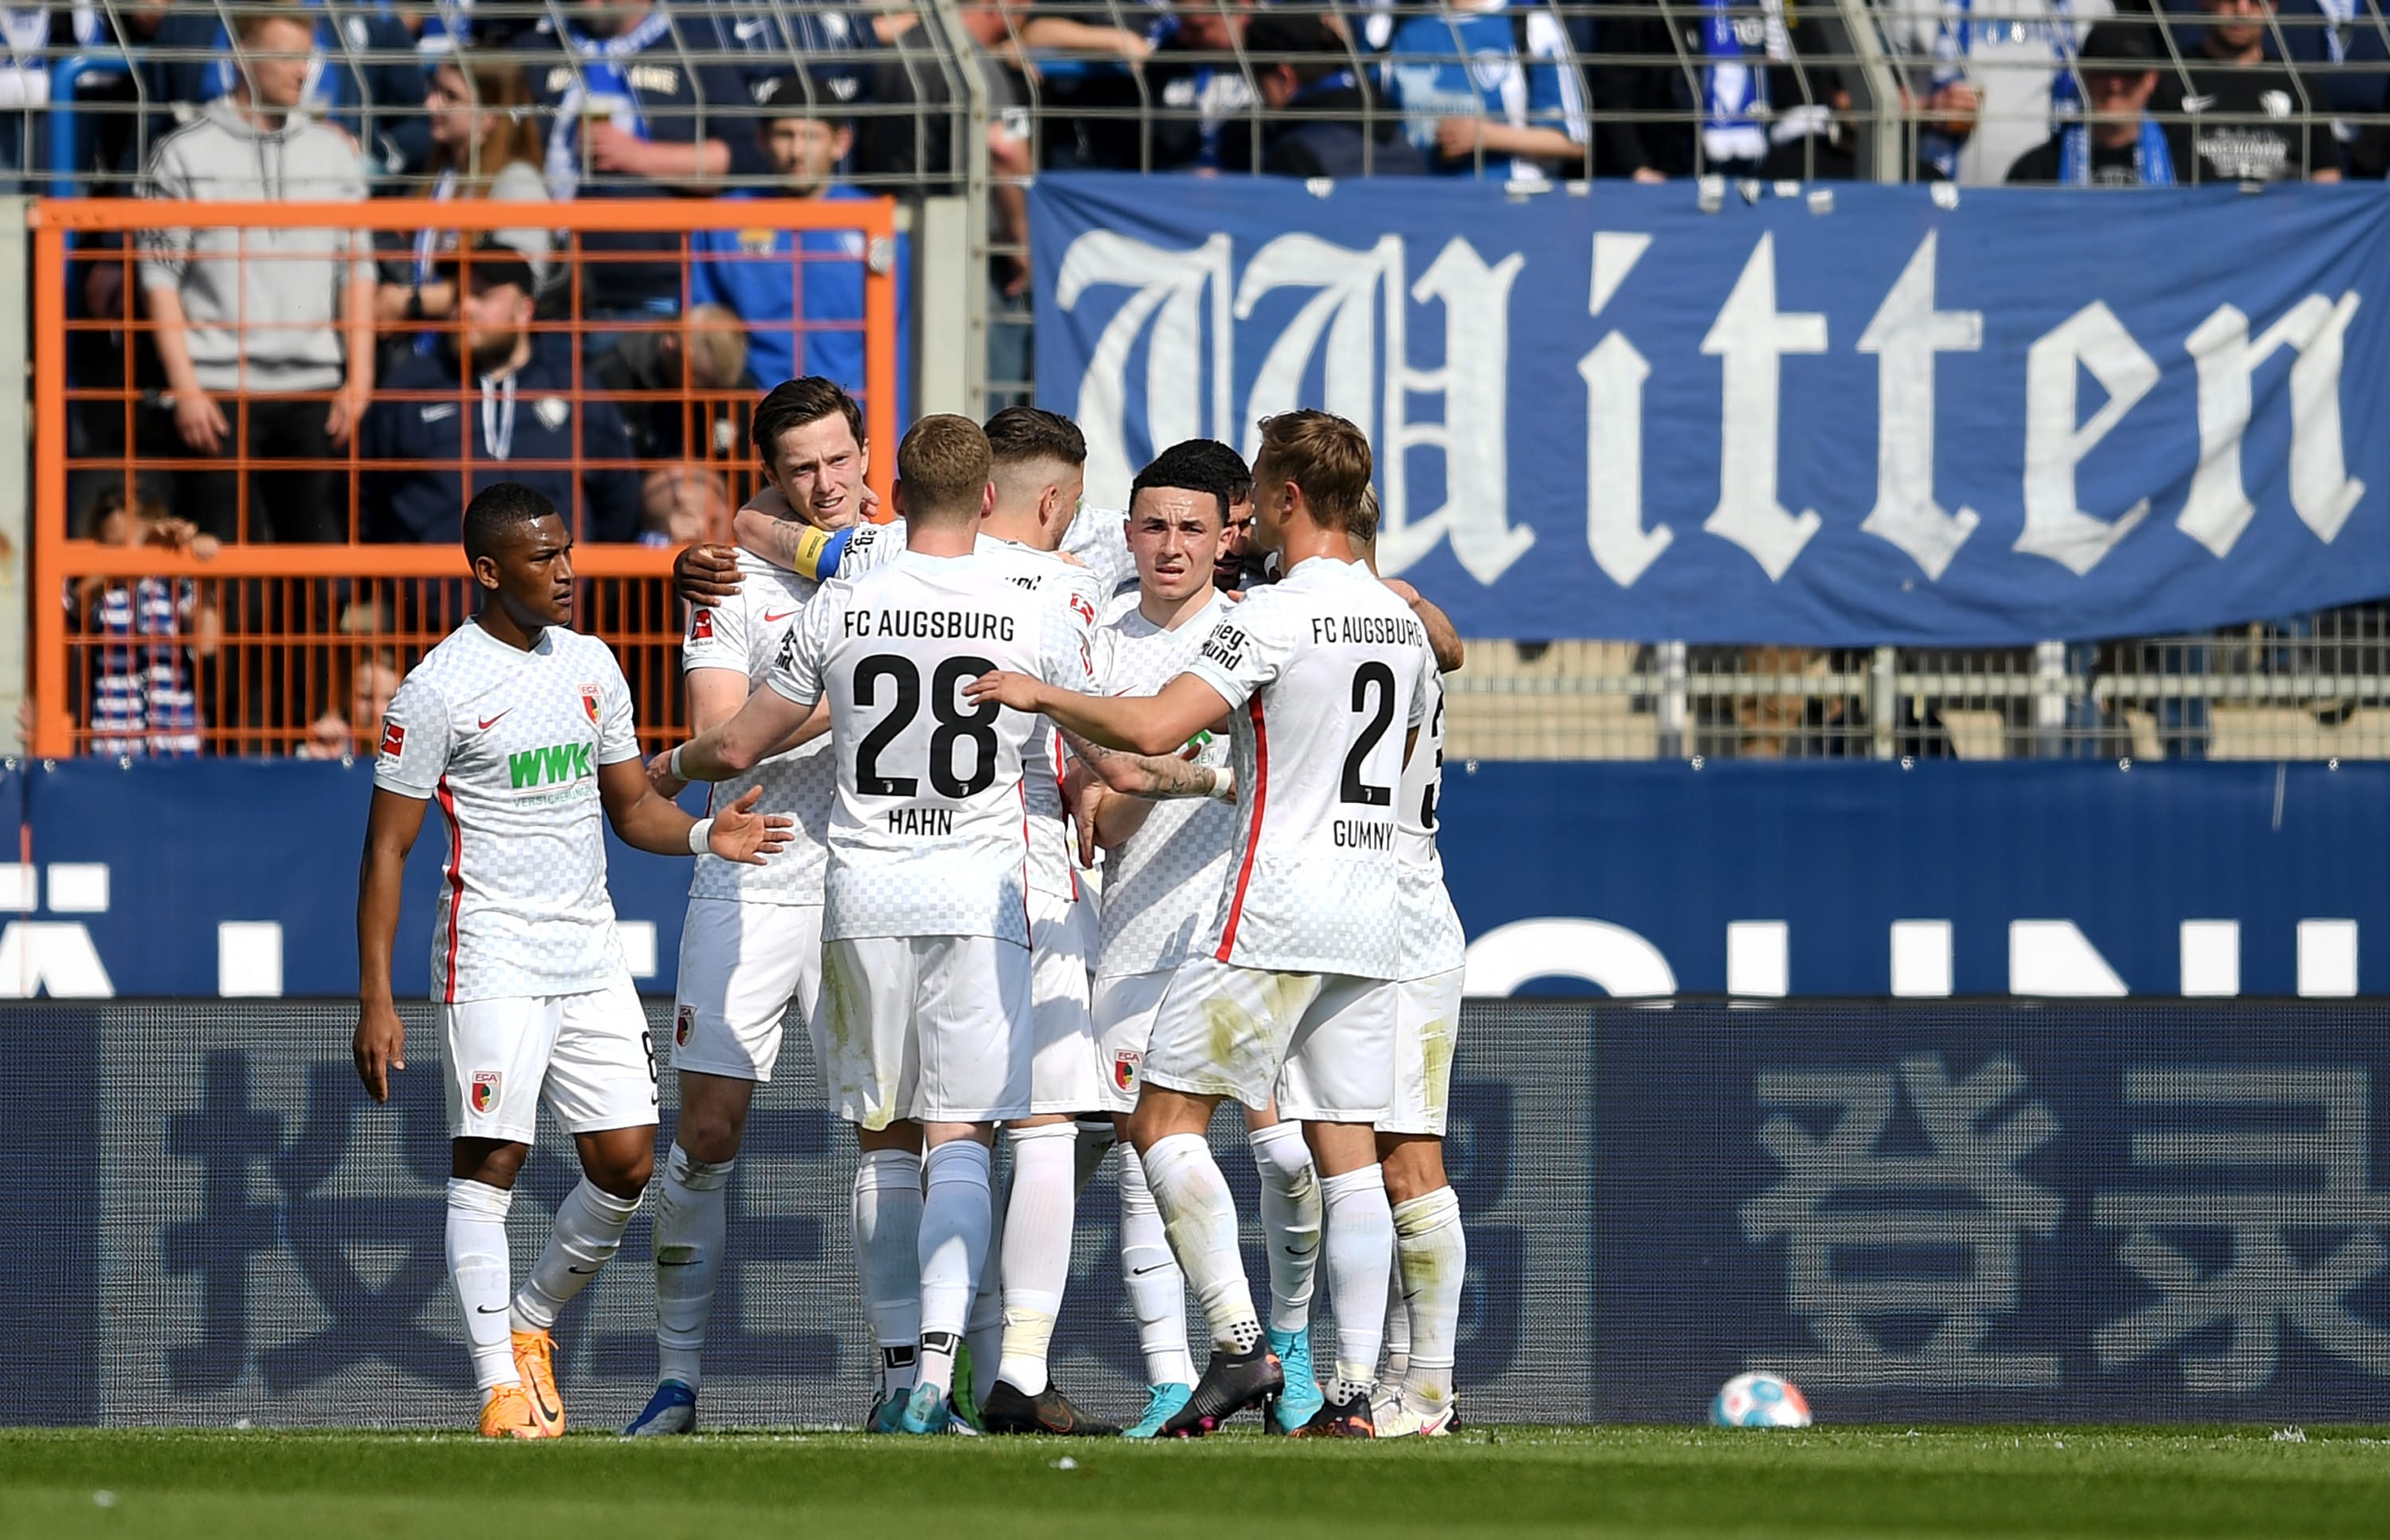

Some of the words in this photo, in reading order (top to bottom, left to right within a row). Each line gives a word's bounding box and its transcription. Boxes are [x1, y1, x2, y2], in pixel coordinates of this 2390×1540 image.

[1056, 228, 2365, 588] Witten
[844, 610, 870, 637] FC
[879, 610, 1013, 641] AUGSBURG
[1311, 616, 1337, 645] FC
[1342, 615, 1423, 648] AUGSBURG
[852, 653, 1002, 800] 28
[1340, 660, 1395, 806] 2
[509, 742, 593, 789] WWK
[888, 807, 954, 837] HAHN
[1334, 819, 1394, 851] GUMNY
